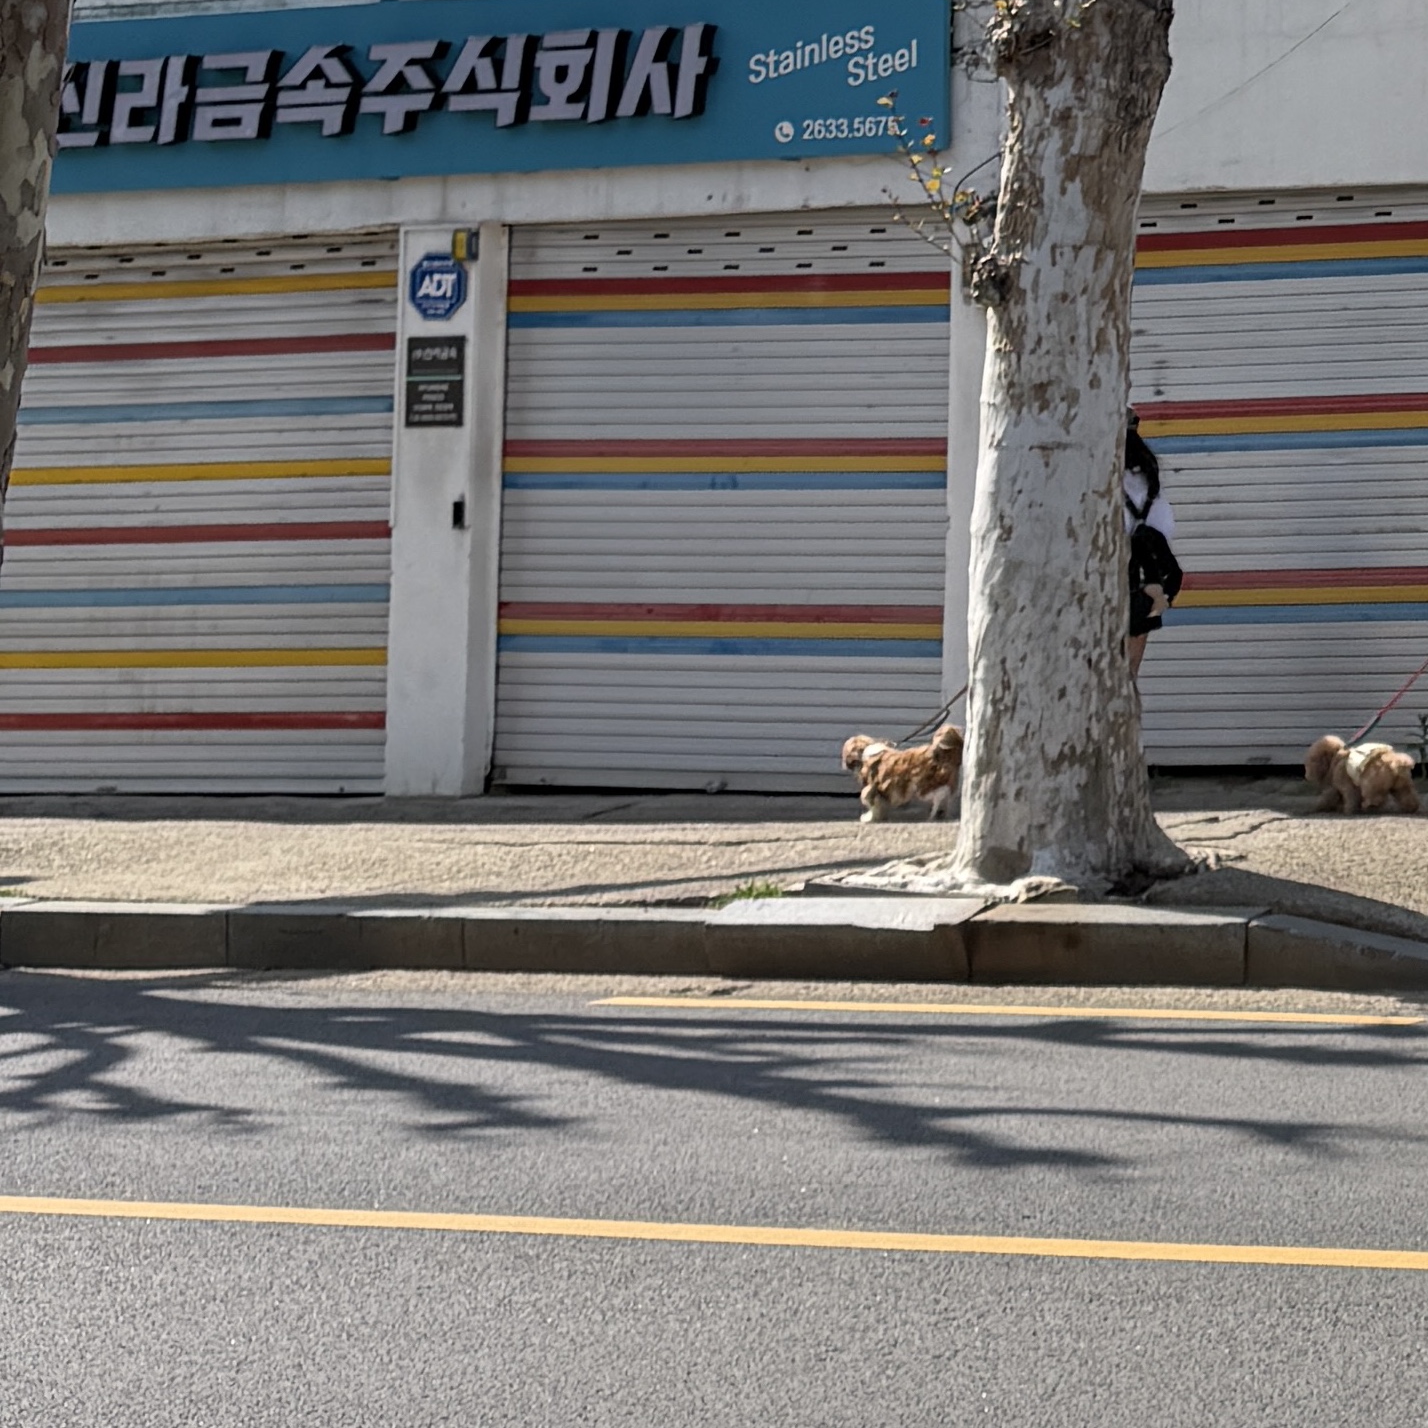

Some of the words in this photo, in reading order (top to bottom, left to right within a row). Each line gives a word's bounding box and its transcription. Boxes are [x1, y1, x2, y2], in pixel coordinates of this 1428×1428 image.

[748, 24, 875, 84] Stainless
[847, 37, 918, 86] Steel
[56, 21, 714, 149] 신라금속주식회사
[416, 273, 458, 299] ADT
